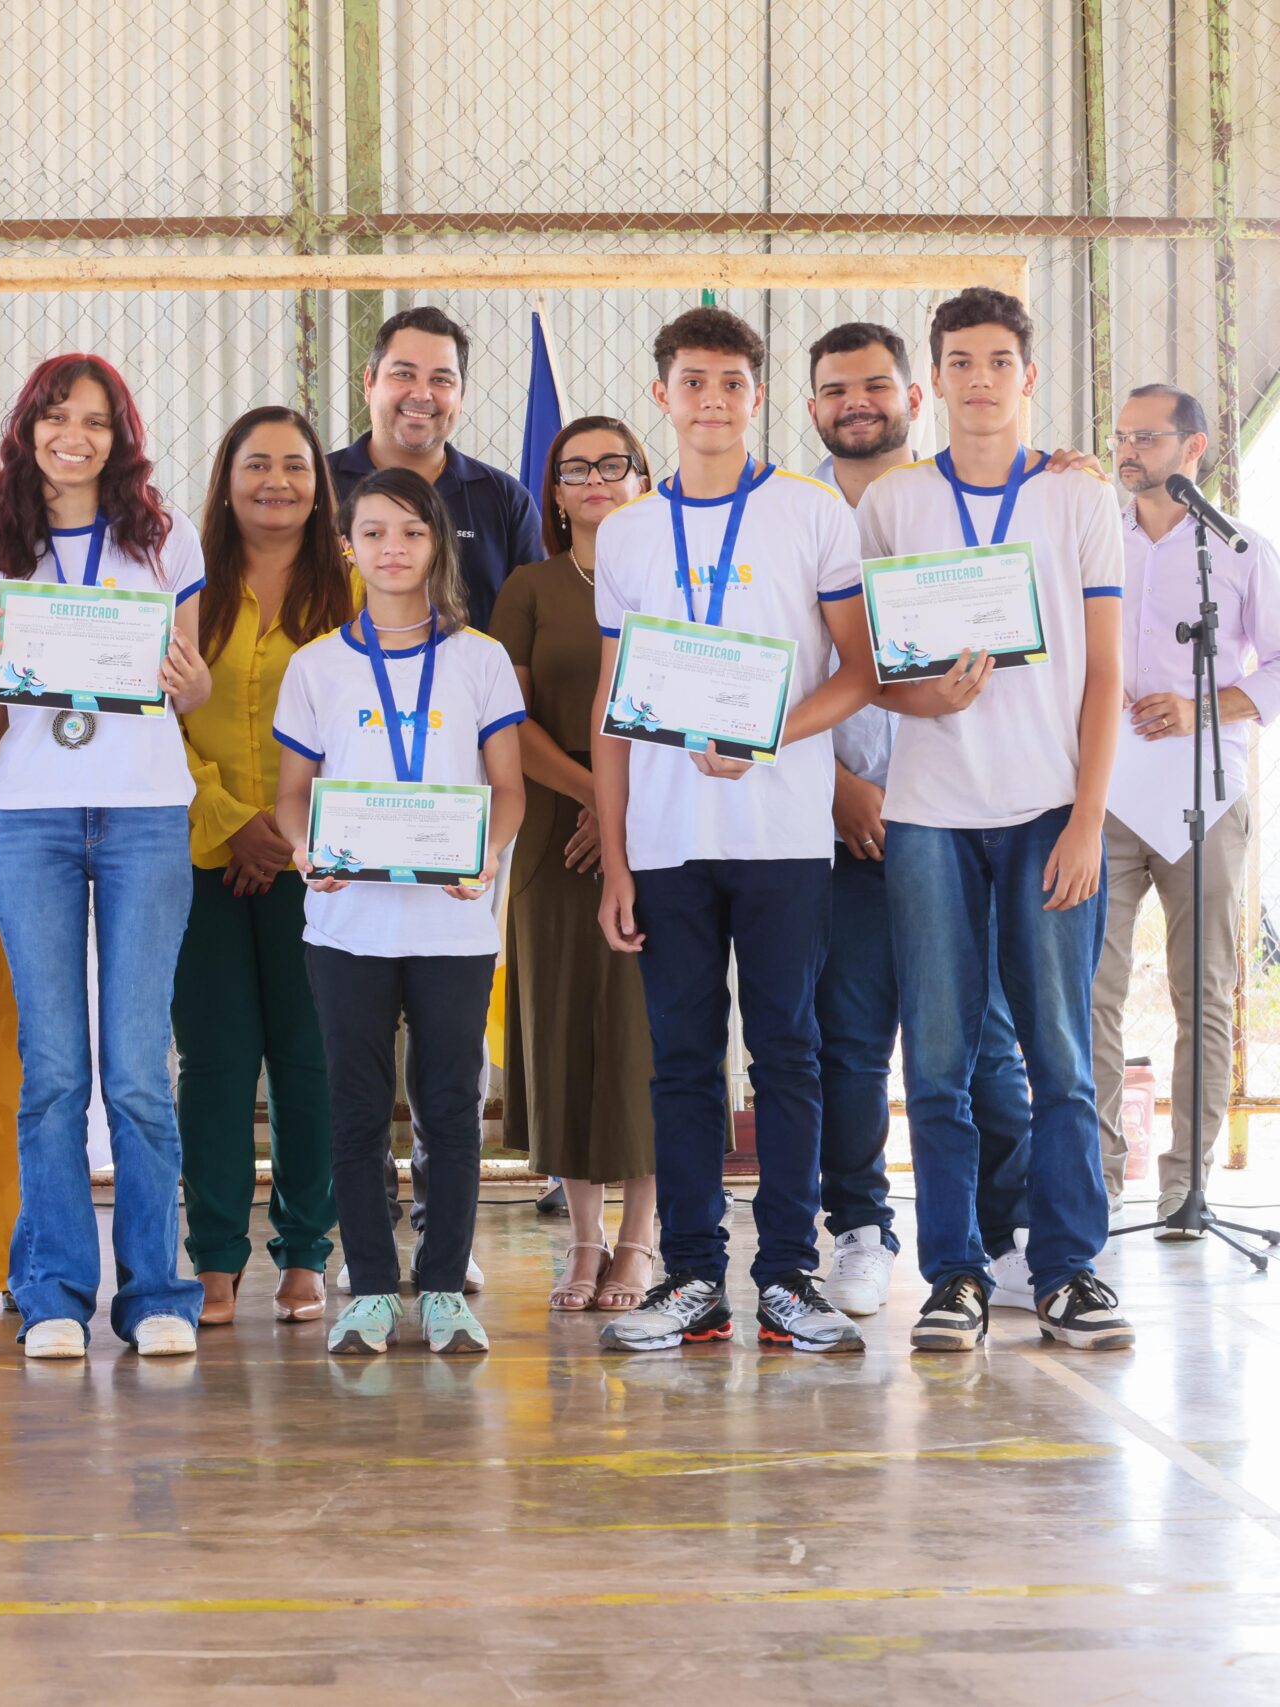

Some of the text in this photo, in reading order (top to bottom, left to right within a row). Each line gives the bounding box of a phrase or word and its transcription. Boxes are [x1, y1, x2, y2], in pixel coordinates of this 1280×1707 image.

[916, 566, 984, 585] CERTIFICADO
[50, 602, 119, 620] CERTIFICADO
[673, 639, 742, 663] CERTIFICADO
[358, 708, 443, 729] PAMS
[365, 796, 436, 809] CERTIFICADO
